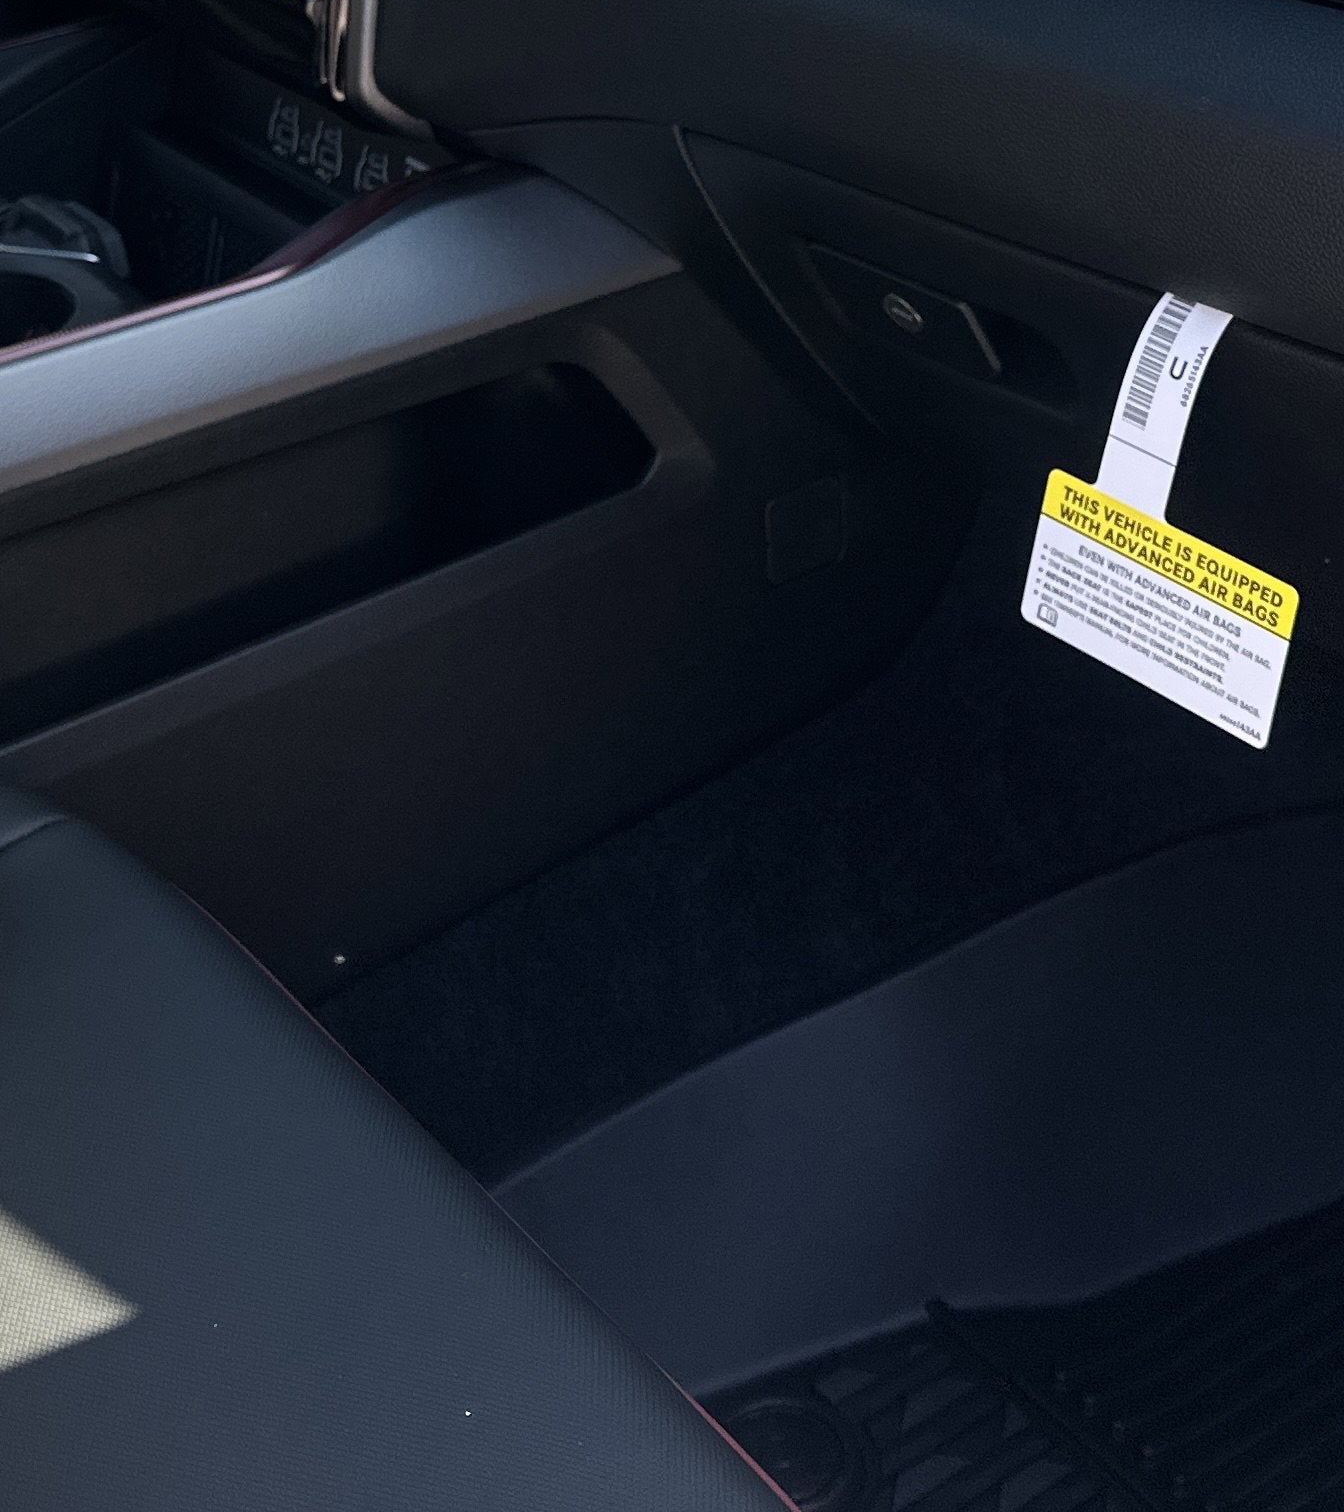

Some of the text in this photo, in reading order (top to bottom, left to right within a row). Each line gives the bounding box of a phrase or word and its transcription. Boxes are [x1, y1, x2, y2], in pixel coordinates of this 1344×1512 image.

[1169, 356, 1189, 381] U
[1059, 504, 1100, 535] WITH
[1104, 527, 1194, 583] ADVANCED
[1199, 575, 1228, 601] AIR
[1232, 592, 1278, 627] BAGS
[1063, 486, 1283, 607] THIS VEHICLE IS EQUIPPED
[1078, 544, 1104, 566] EVEN
[1107, 559, 1133, 581] WITH
[1135, 574, 1191, 611] ADVANCED
[1192, 604, 1211, 622] AIR
[1212, 614, 1242, 638] BAGS
